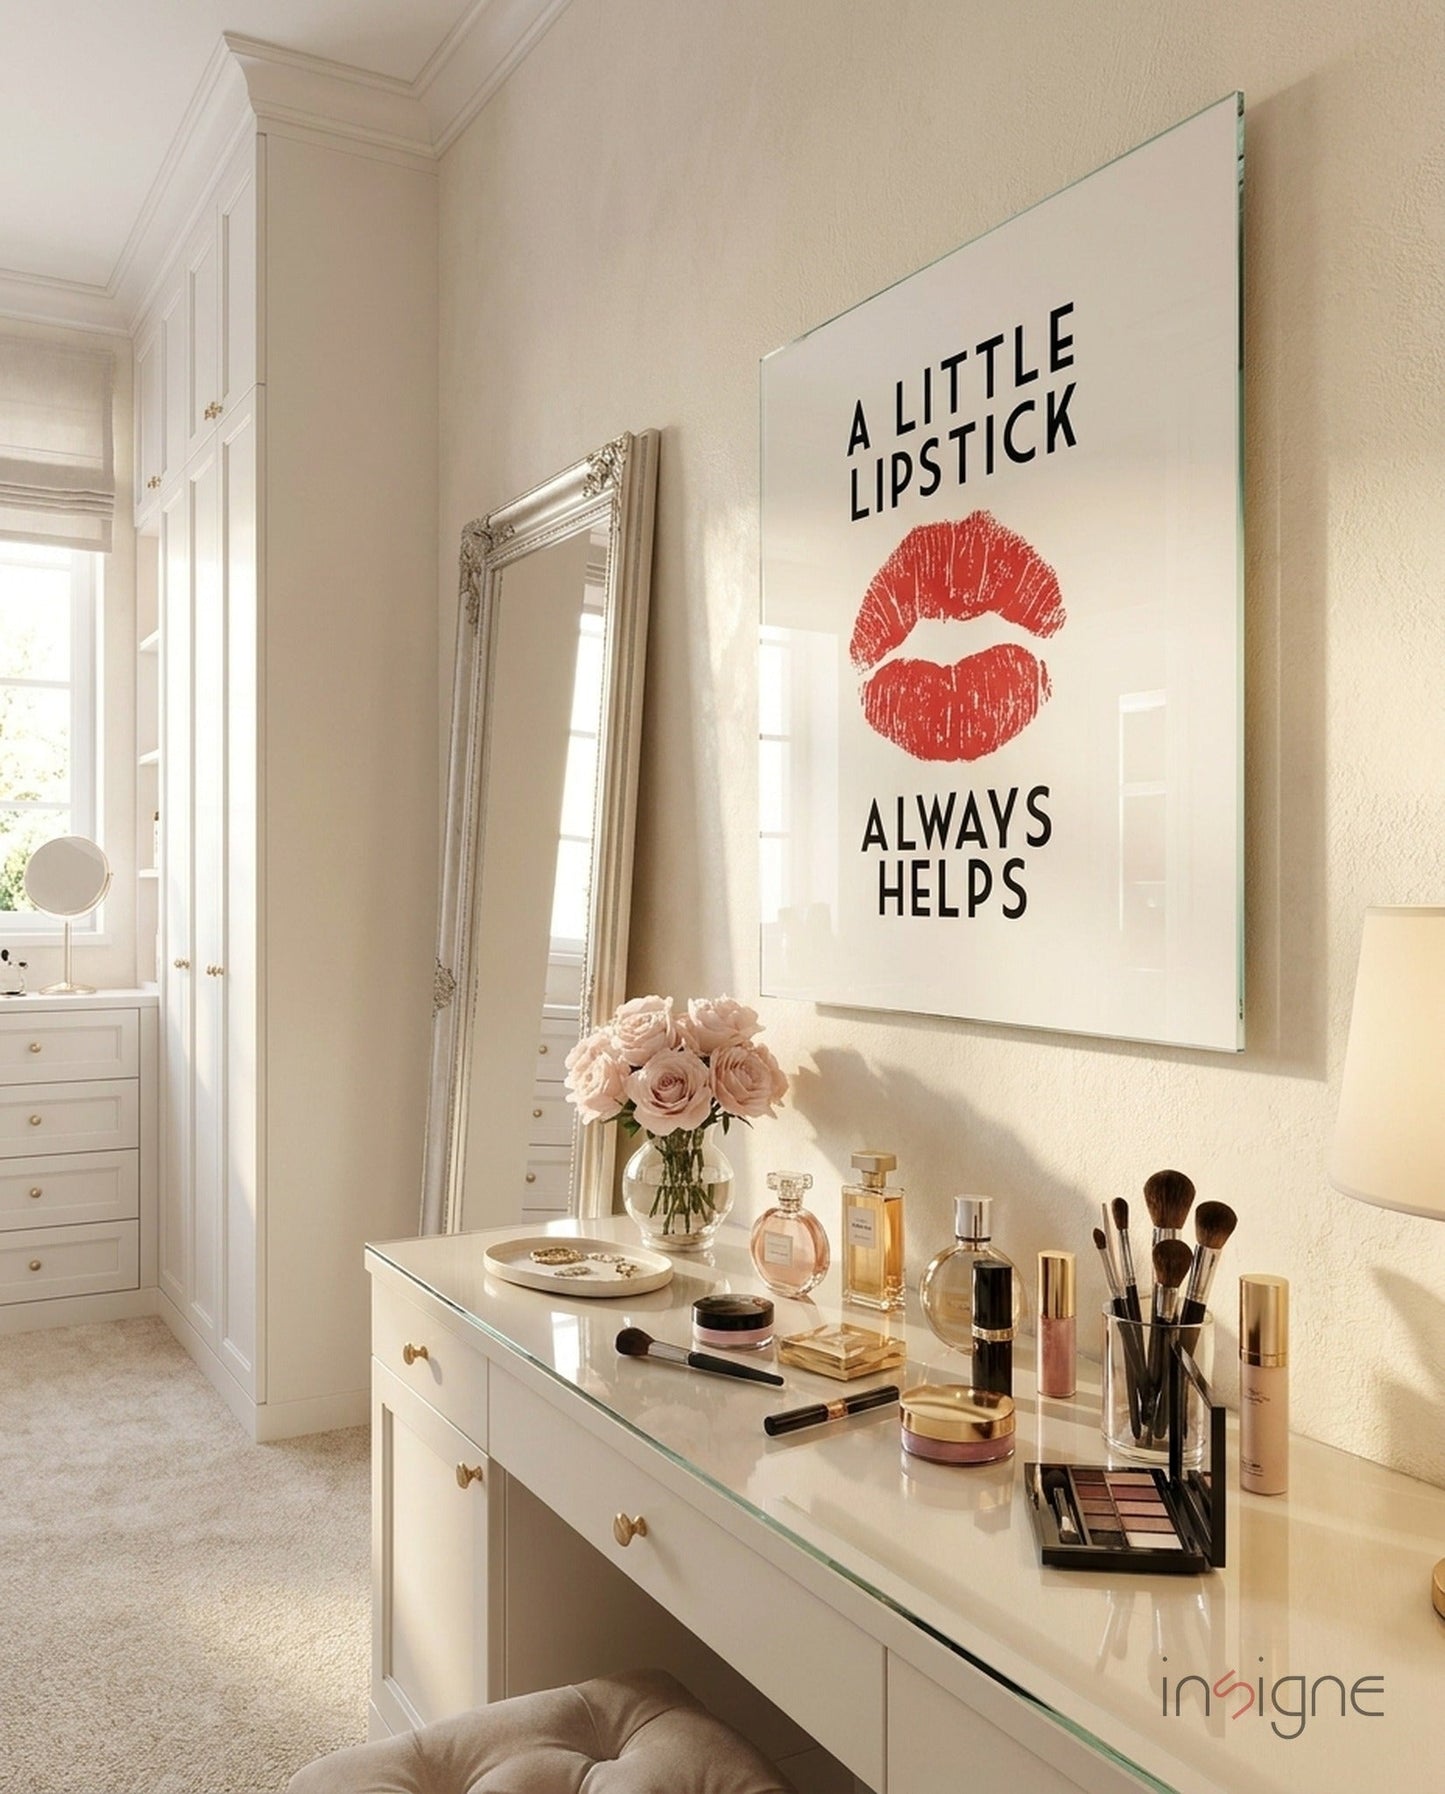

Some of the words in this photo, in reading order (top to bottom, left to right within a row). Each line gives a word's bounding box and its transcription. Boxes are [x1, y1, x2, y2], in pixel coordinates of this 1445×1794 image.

[847, 400, 870, 456] A
[897, 301, 1074, 436] LITTLE
[851, 382, 1077, 521] LIPSTICK
[861, 785, 1051, 852] ALWAYS
[879, 857, 1027, 920] HELPS
